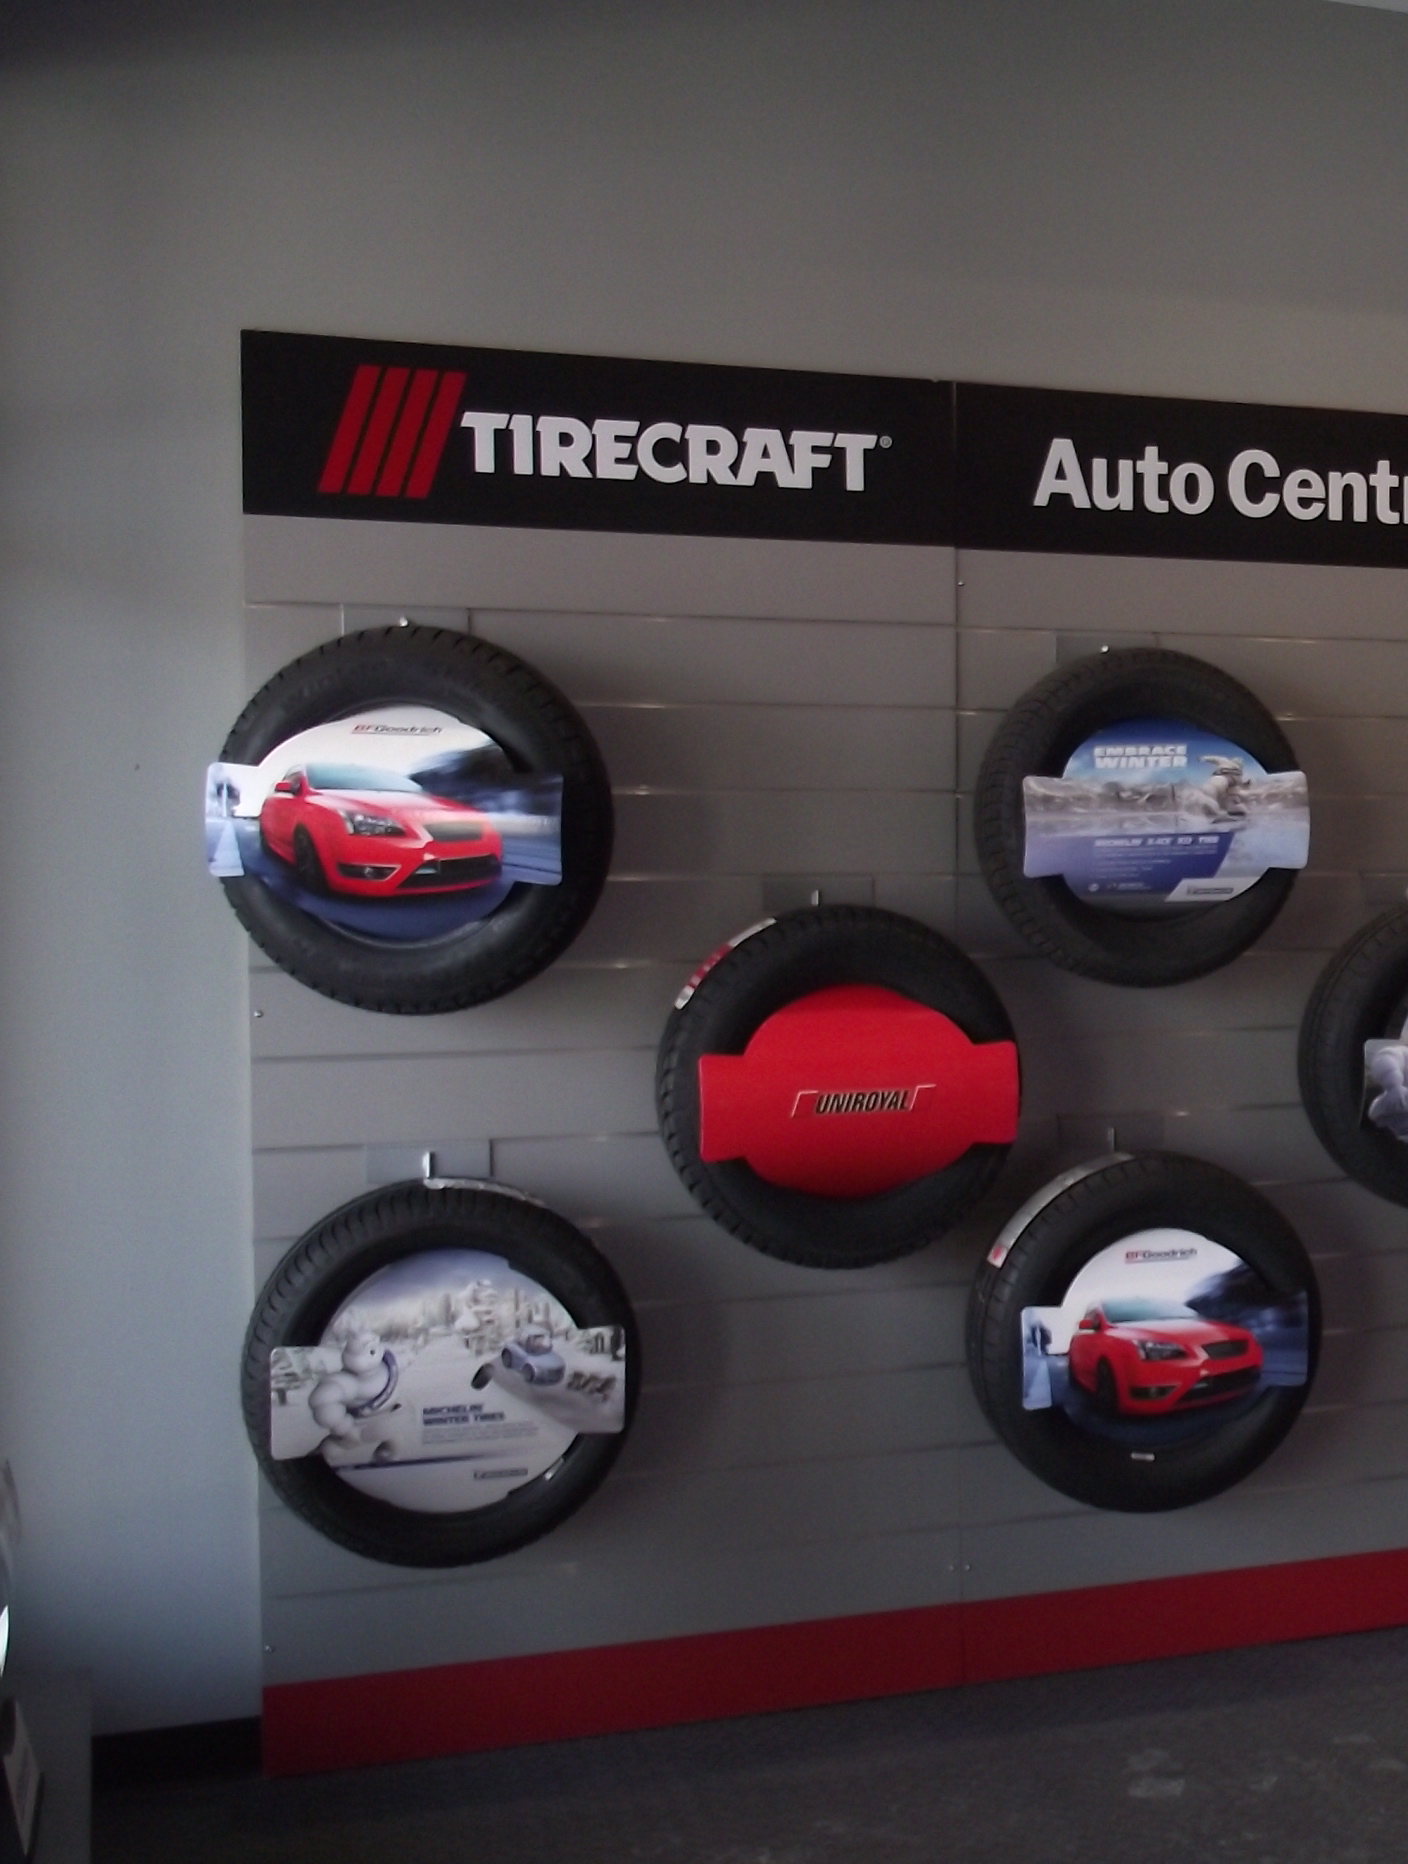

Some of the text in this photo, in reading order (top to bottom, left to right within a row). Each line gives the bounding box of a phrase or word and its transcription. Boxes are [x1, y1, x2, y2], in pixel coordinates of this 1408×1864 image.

[460, 411, 878, 492] TIRECRAFT
[1033, 437, 1215, 515] Auto
[1094, 744, 1188, 756] EMBRACE
[1094, 756, 1188, 769] WINTER
[816, 1090, 909, 1113] UNIROYAL
[1125, 1248, 1198, 1260] BFGoodrich
[423, 1404, 483, 1415] MICHELIN
[424, 1412, 505, 1426] WINTER TIRES
